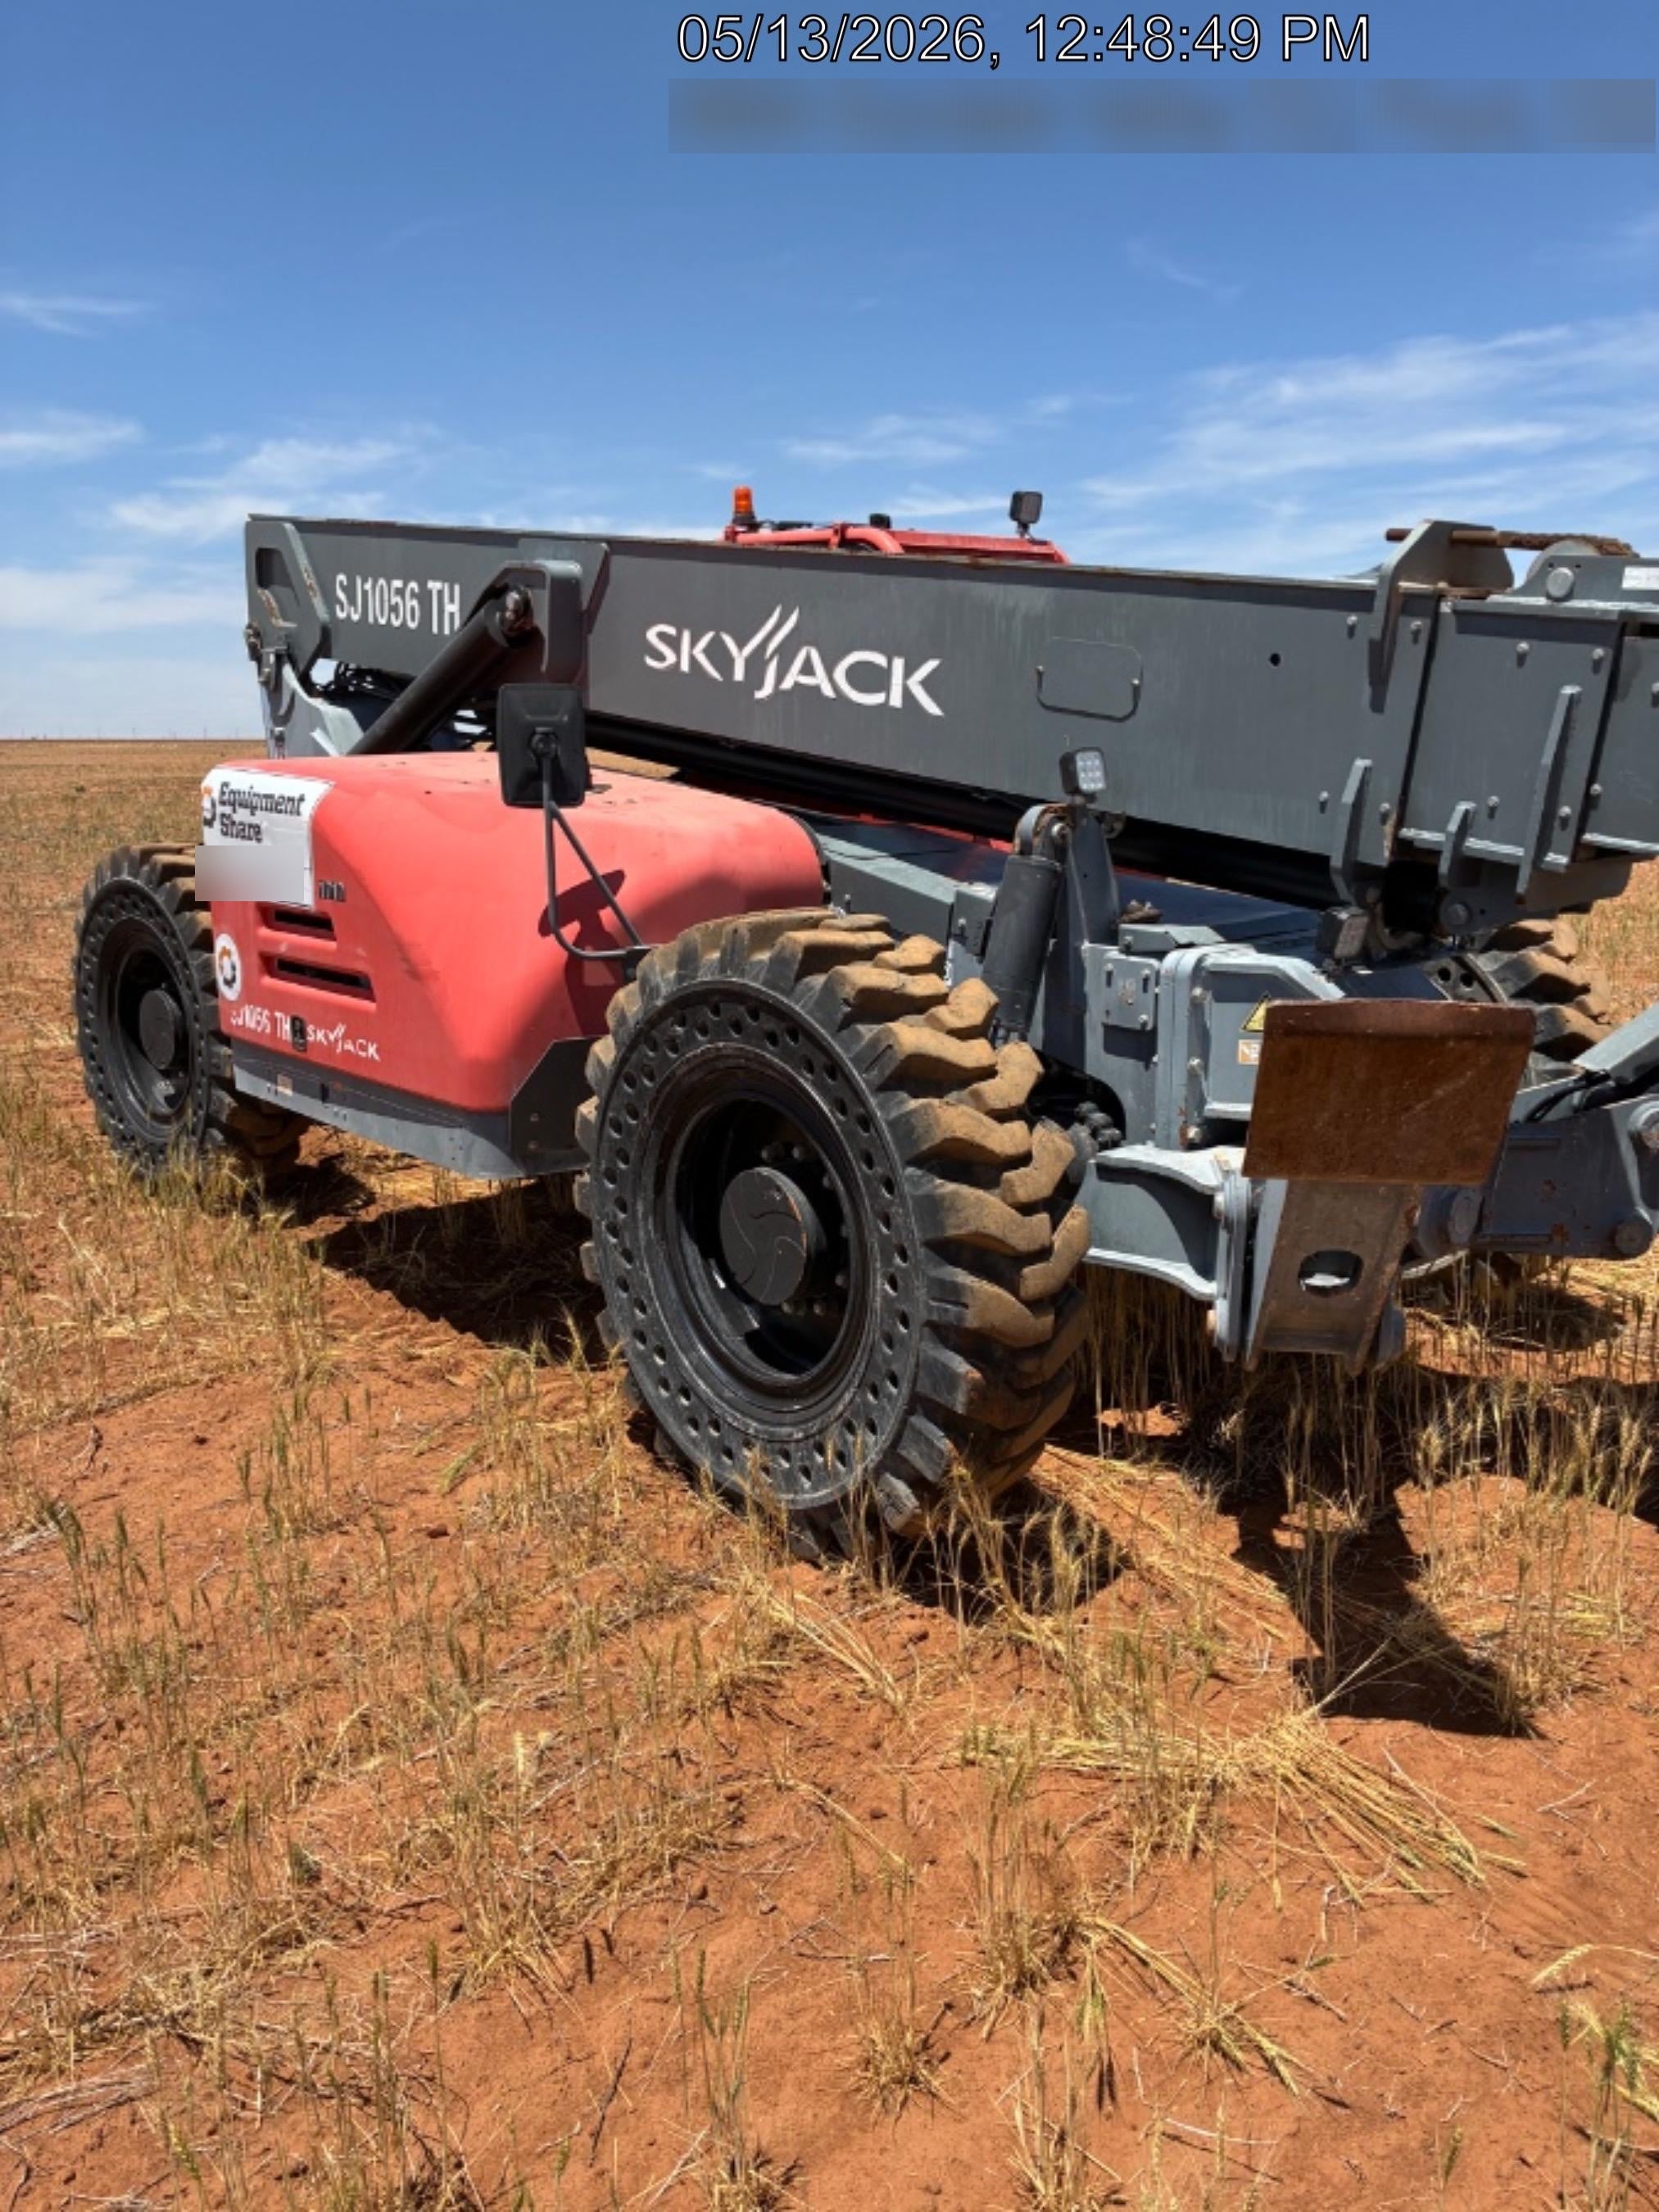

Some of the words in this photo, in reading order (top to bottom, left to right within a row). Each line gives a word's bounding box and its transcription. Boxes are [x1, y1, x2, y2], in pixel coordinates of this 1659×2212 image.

[335, 572, 420, 630] SJ1056
[426, 578, 461, 636] TH
[644, 604, 945, 717] SKYJACK
[219, 781, 306, 816] Equipment
[220, 812, 263, 844] Share
[274, 1011, 292, 1042] TH
[306, 1022, 380, 1063] SKYJACK
